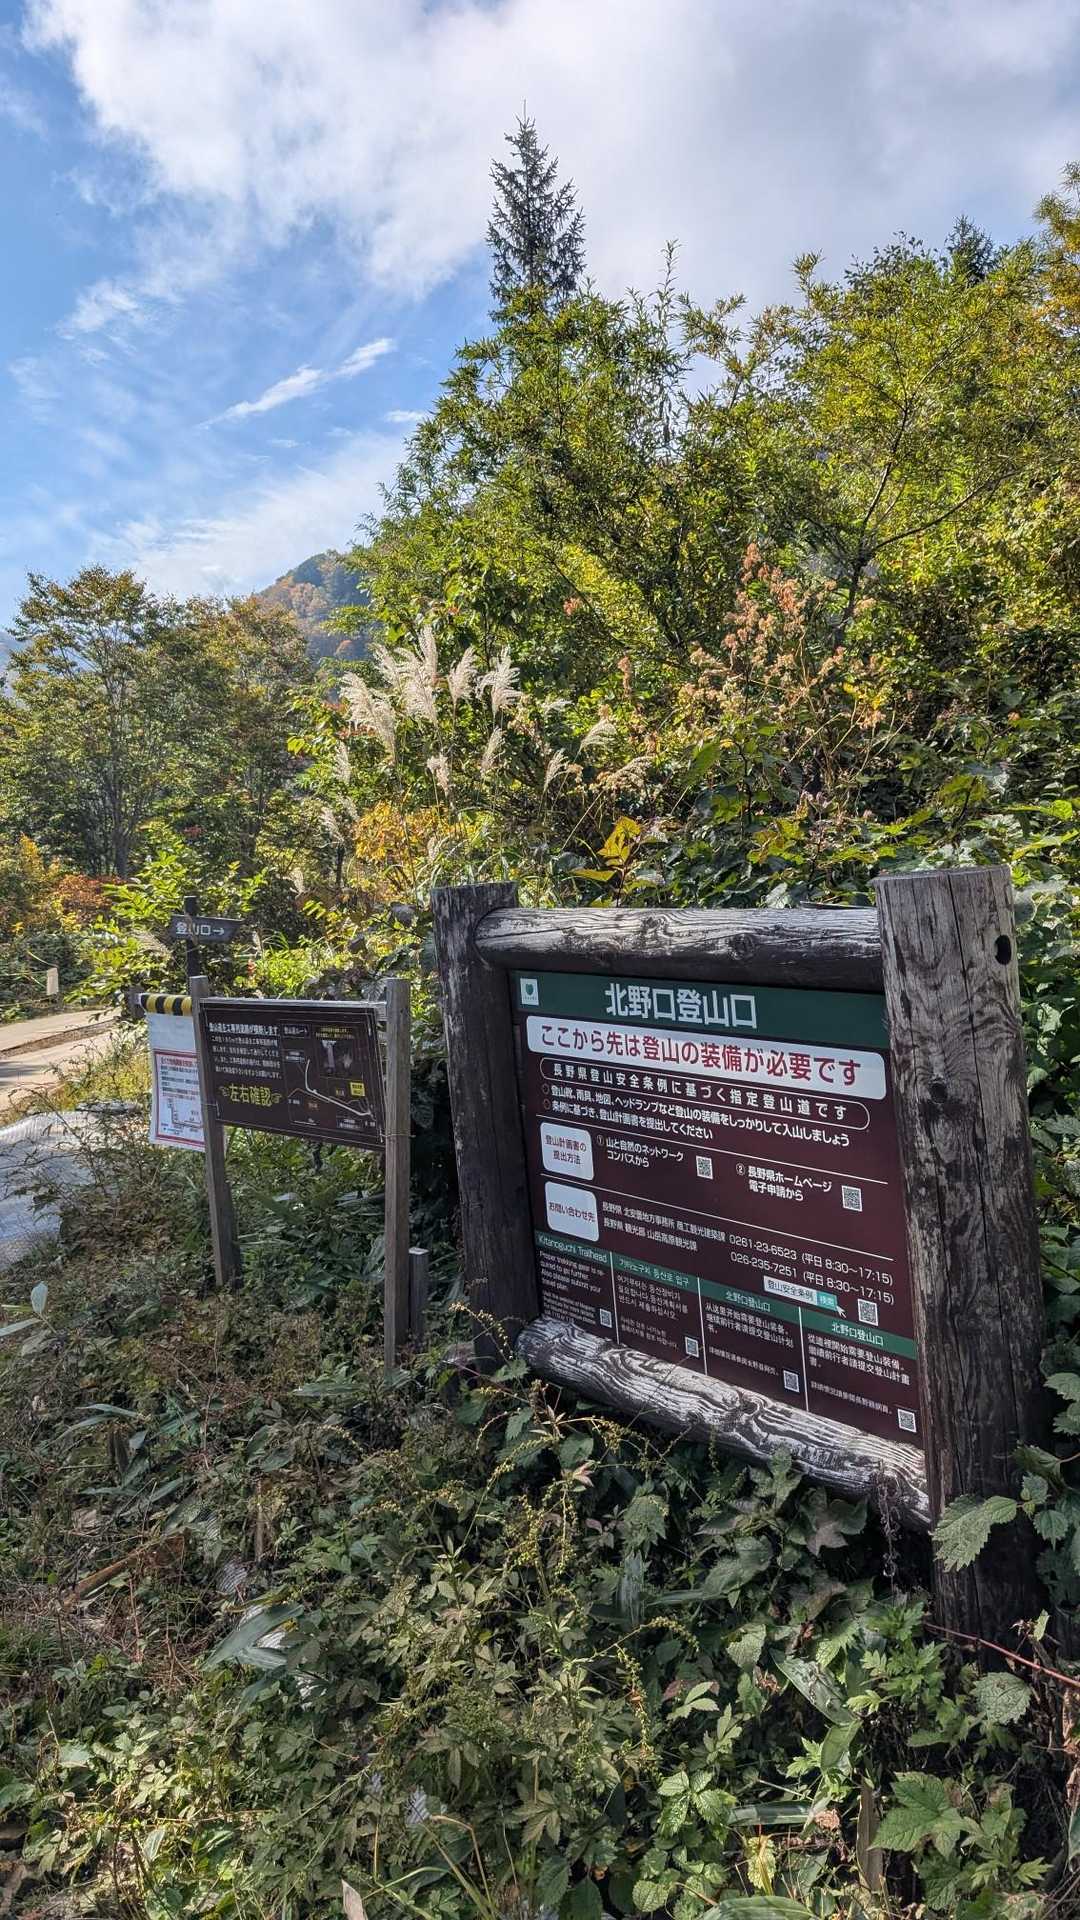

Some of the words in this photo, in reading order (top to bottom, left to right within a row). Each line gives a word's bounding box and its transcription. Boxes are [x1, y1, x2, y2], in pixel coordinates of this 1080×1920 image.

[604, 982, 757, 1029] 北野口登山口
[541, 1025, 861, 1086] ここから先は登山の装備が必要です
[228, 1083, 272, 1107] 左右確認
[553, 1063, 847, 1120] 長野県登山安全条例に基づく指定登山道です
[552, 1100, 713, 1139] 条例に基づき、登山計画書を提出してください
[545, 1134, 587, 1152] 登山計画書の
[606, 1136, 684, 1162] 山と自然のネットワーク
[553, 1150, 581, 1165] 提出方法
[607, 1150, 649, 1168] コンパスから
[748, 1166, 832, 1192] 長野県ホームページ
[749, 1180, 804, 1202] 電子申請から
[548, 1201, 596, 1223] お問い合わせ先
[577, 1246, 607, 1263] Trailhead
[729, 1234, 797, 1260] 0261-23-6523
[730, 1252, 797, 1278] 026-235-7251
[831, 1320, 883, 1346] 北野口登山口
